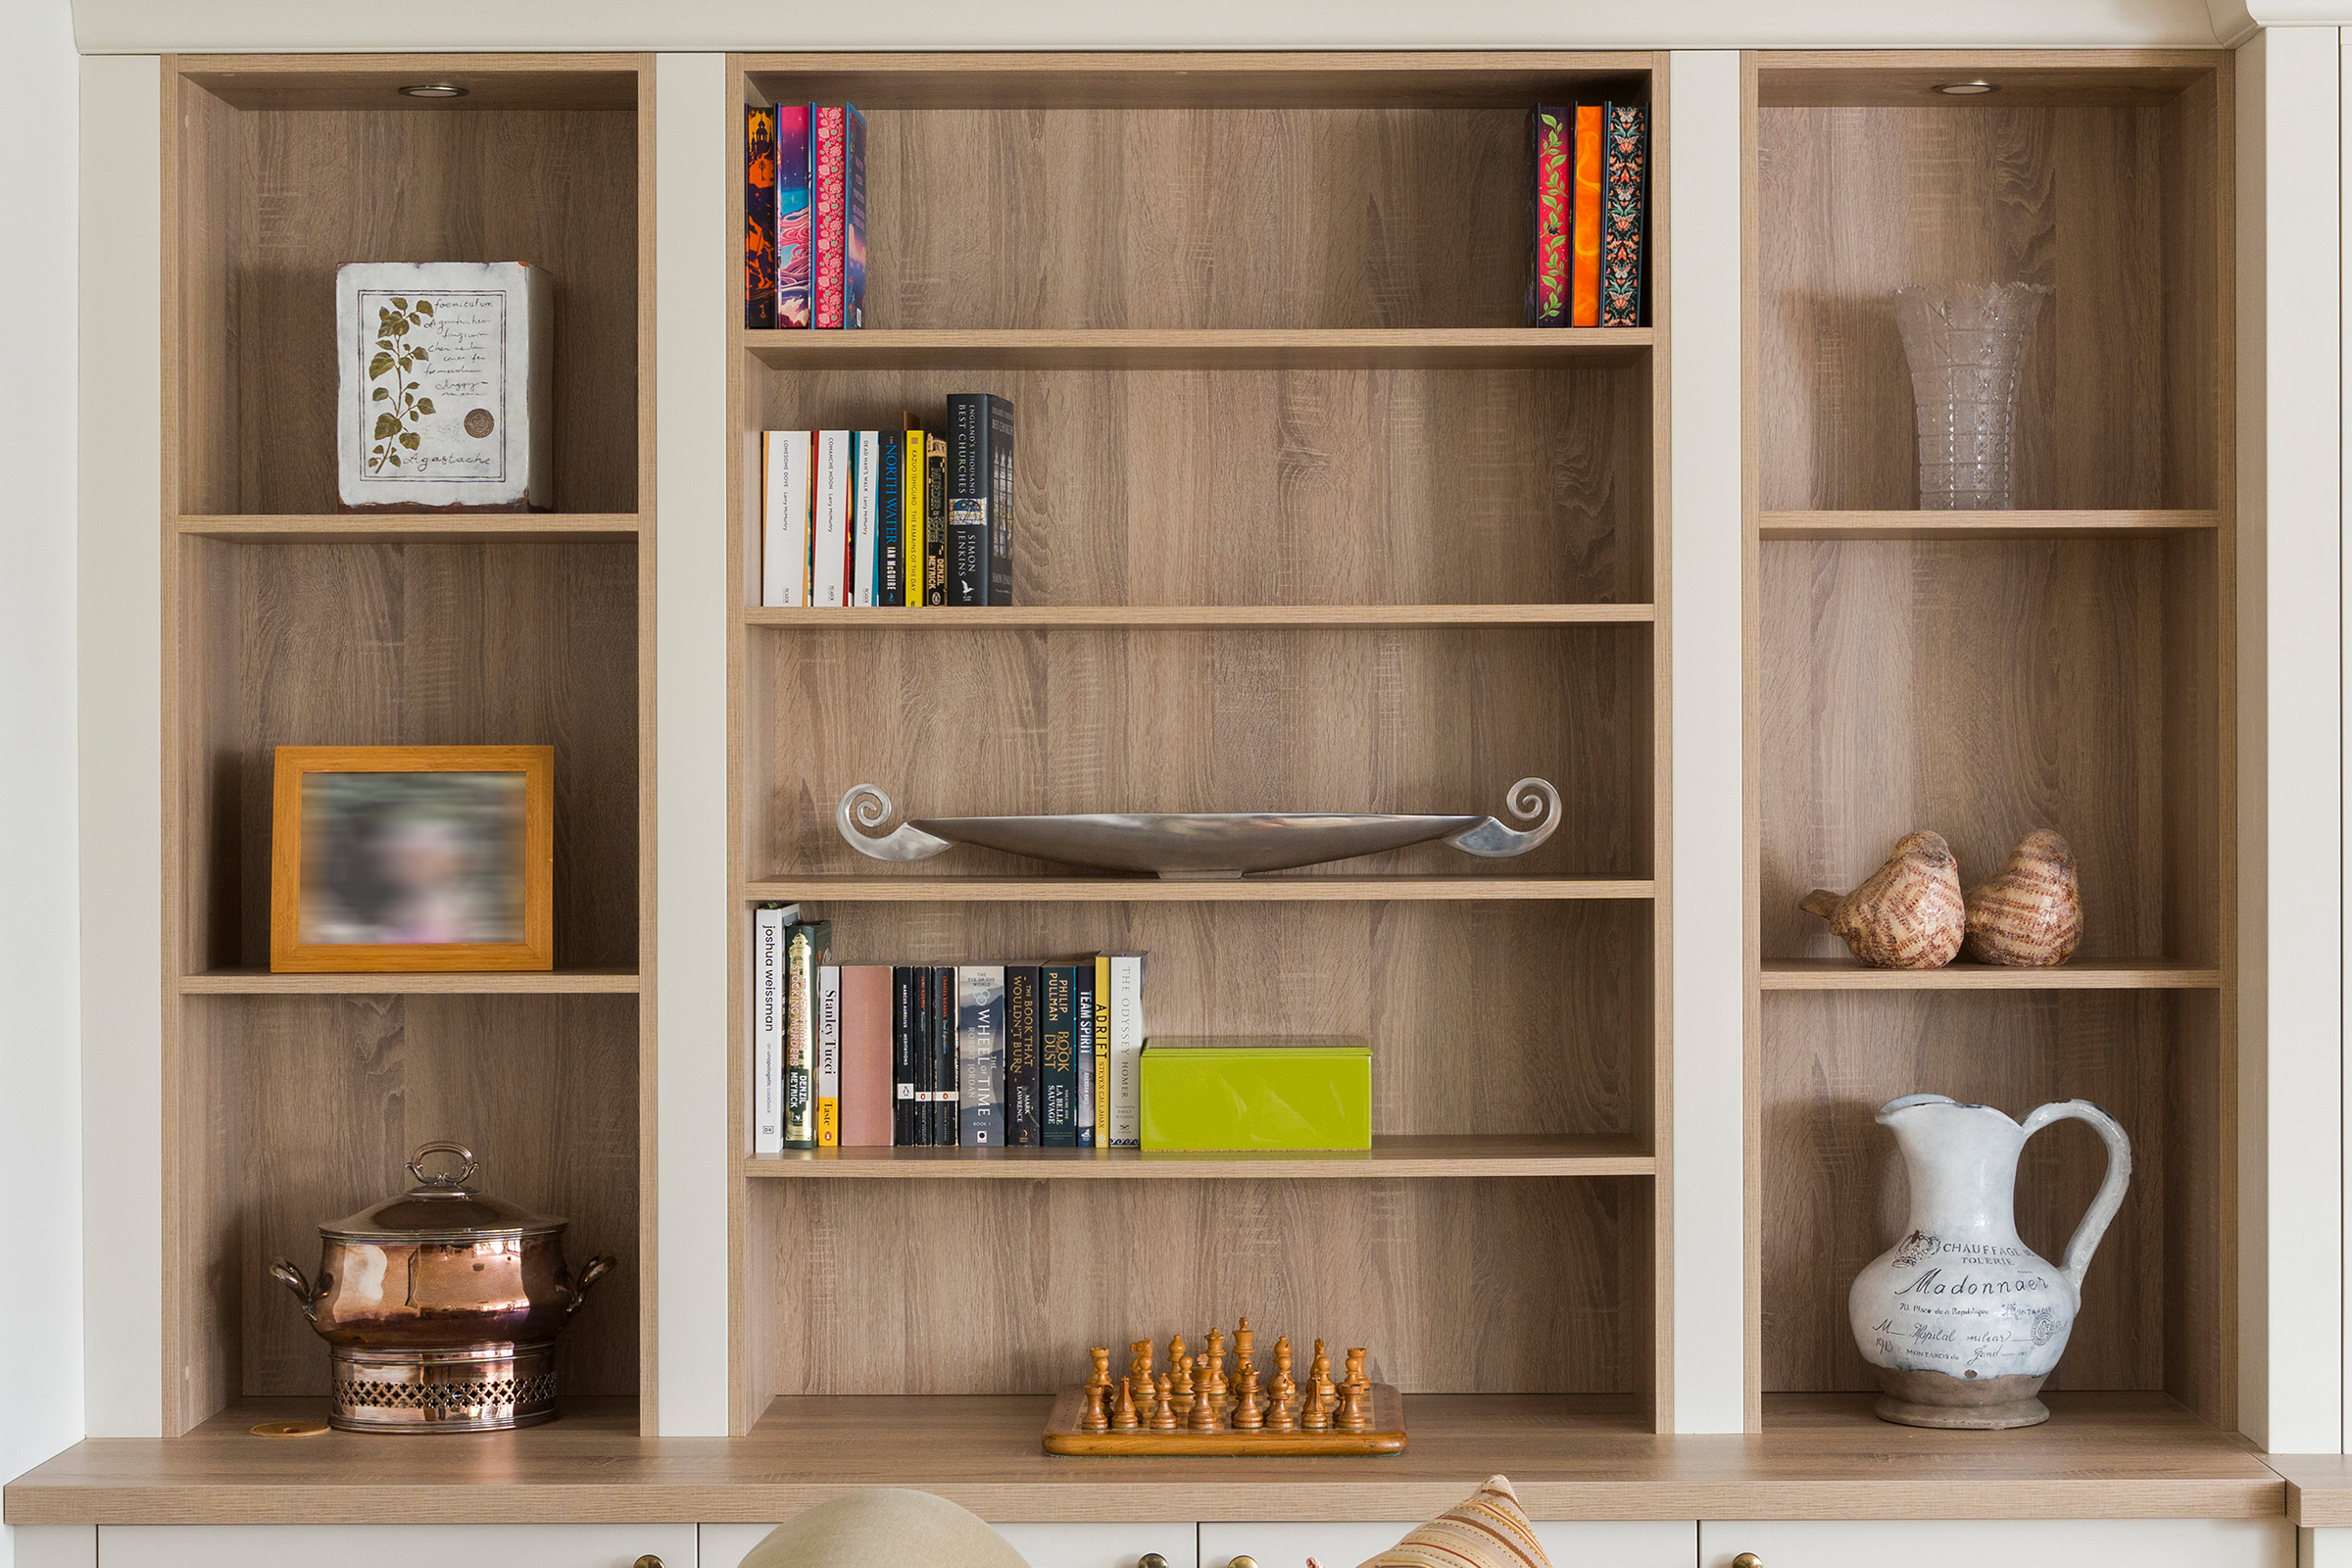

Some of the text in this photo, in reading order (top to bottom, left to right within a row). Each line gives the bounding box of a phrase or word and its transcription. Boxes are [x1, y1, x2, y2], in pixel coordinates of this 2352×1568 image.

[403, 452, 491, 472] Agastache
[957, 433, 966, 494] CHURCHES
[885, 444, 898, 544] NORTH WATER
[887, 546, 896, 590] IAN McGUIRE
[910, 554, 916, 564] OF
[957, 530, 966, 576] JENKINS
[762, 925, 776, 1032] joshua weissman
[1049, 972, 1058, 1021] PULLMAN
[1058, 980, 1068, 1014] PHILIP
[1121, 966, 1130, 992] THE
[790, 964, 800, 1066] STOCKING MURDERS
[821, 990, 837, 1075] Stanley Tucci
[1009, 975, 1022, 1074] WOULDN'T BURN
[1024, 1001, 1033, 1034] BOOK
[1080, 990, 1092, 1054] TEAM SPIRIT
[1096, 1004, 1107, 1058] ADRIFT
[1120, 998, 1130, 1055] ODYSSEY
[978, 1008, 990, 1116] WHEEL OF TIME
[1024, 1035, 1033, 1066] THAT
[1044, 1034, 1056, 1069] DUST
[1057, 1031, 1069, 1073] BOOK
[790, 1071, 799, 1108] MEYRICK
[1056, 1084, 1063, 1097] LA
[823, 1102, 833, 1126] Taste
[1942, 1243, 2021, 1256] CHAUFFAGE
[1961, 1256, 2015, 1266] TOLERIE
[1894, 1267, 2049, 1295] Madonnaer
